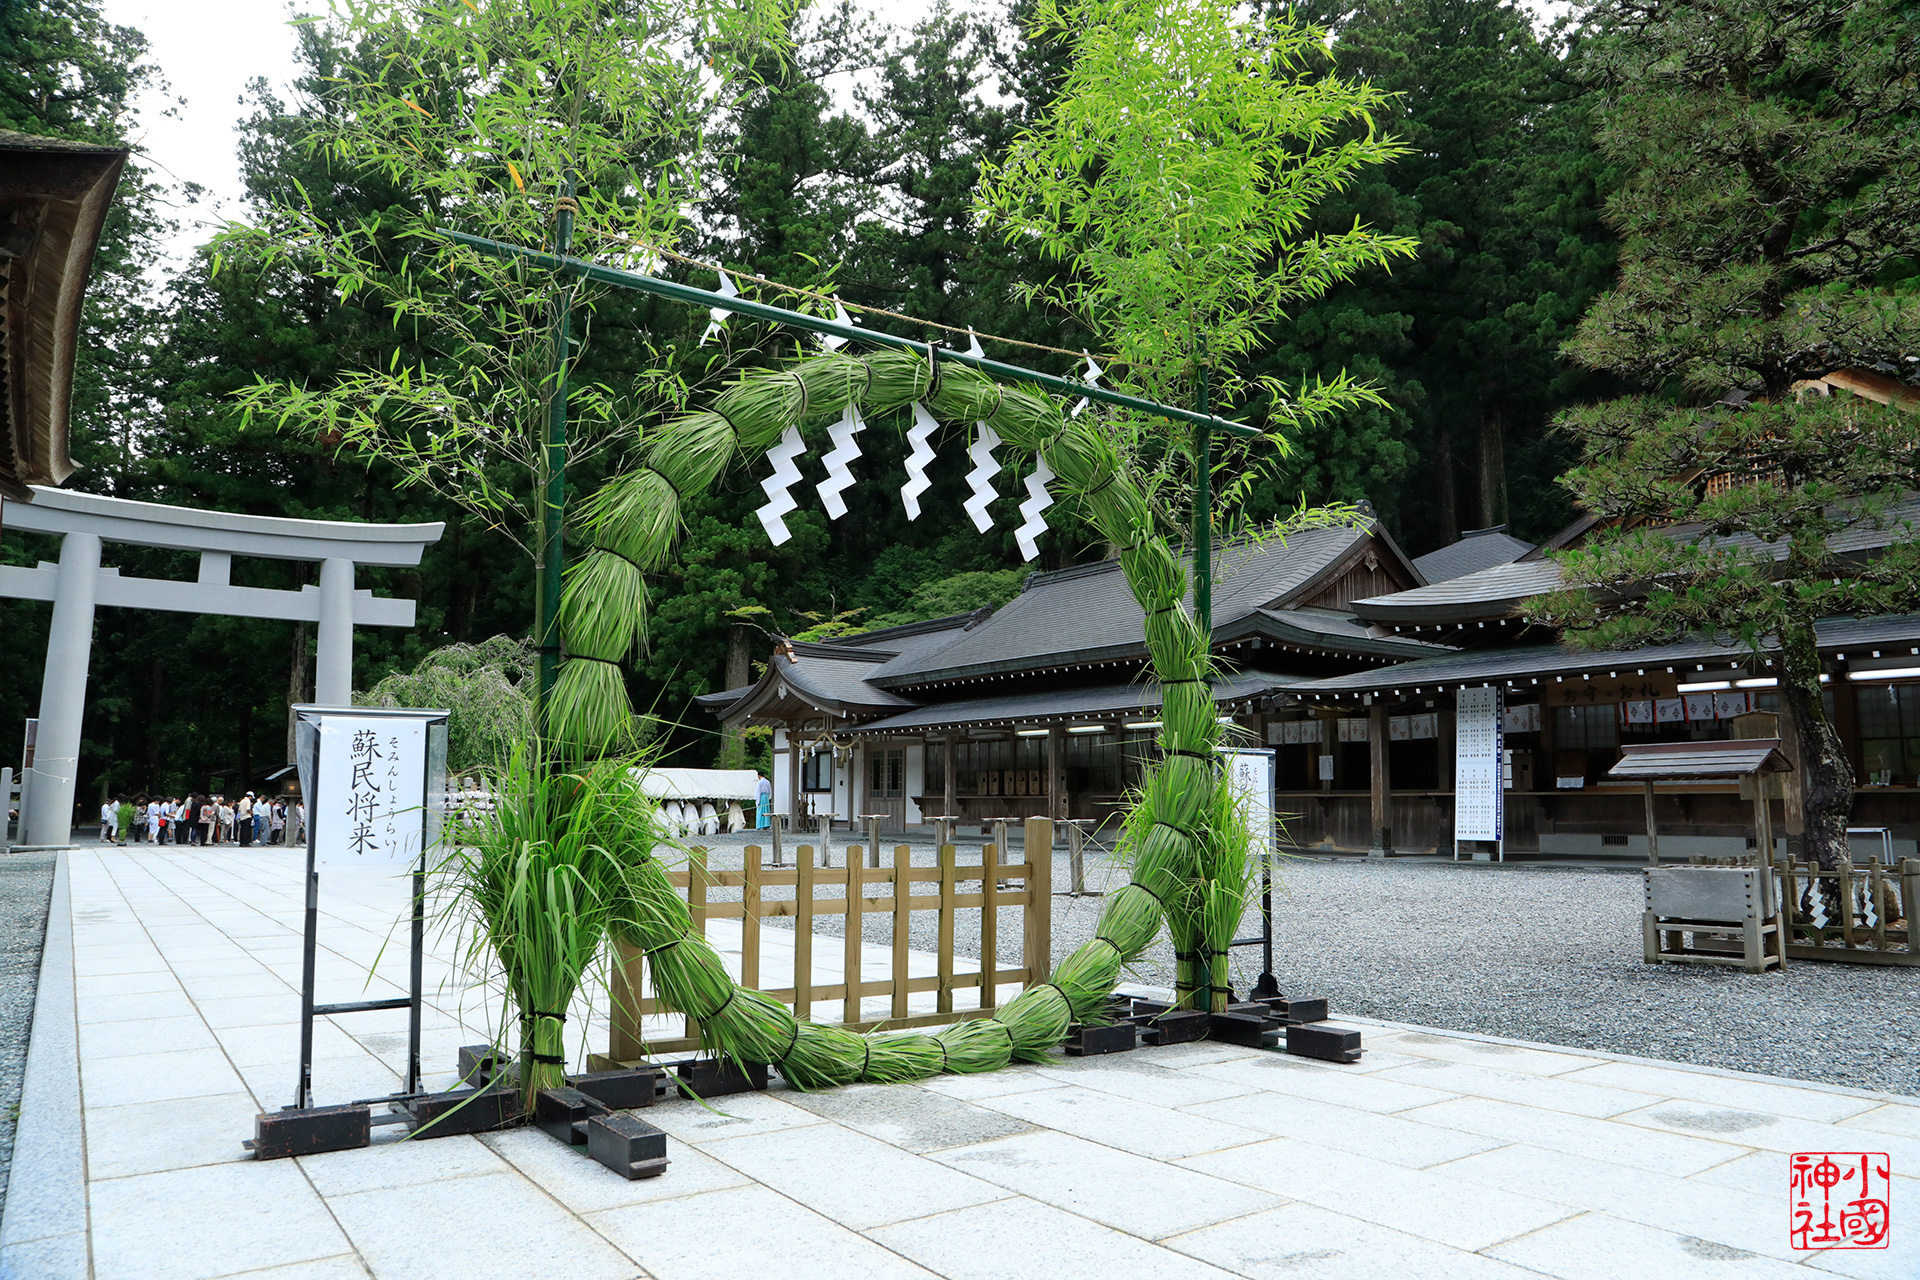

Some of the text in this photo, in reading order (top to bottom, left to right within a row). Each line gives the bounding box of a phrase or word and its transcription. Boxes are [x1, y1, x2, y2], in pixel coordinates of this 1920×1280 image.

[346, 729, 383, 856] 蘇民将来
[385, 736, 400, 848] そみんしょうらい
